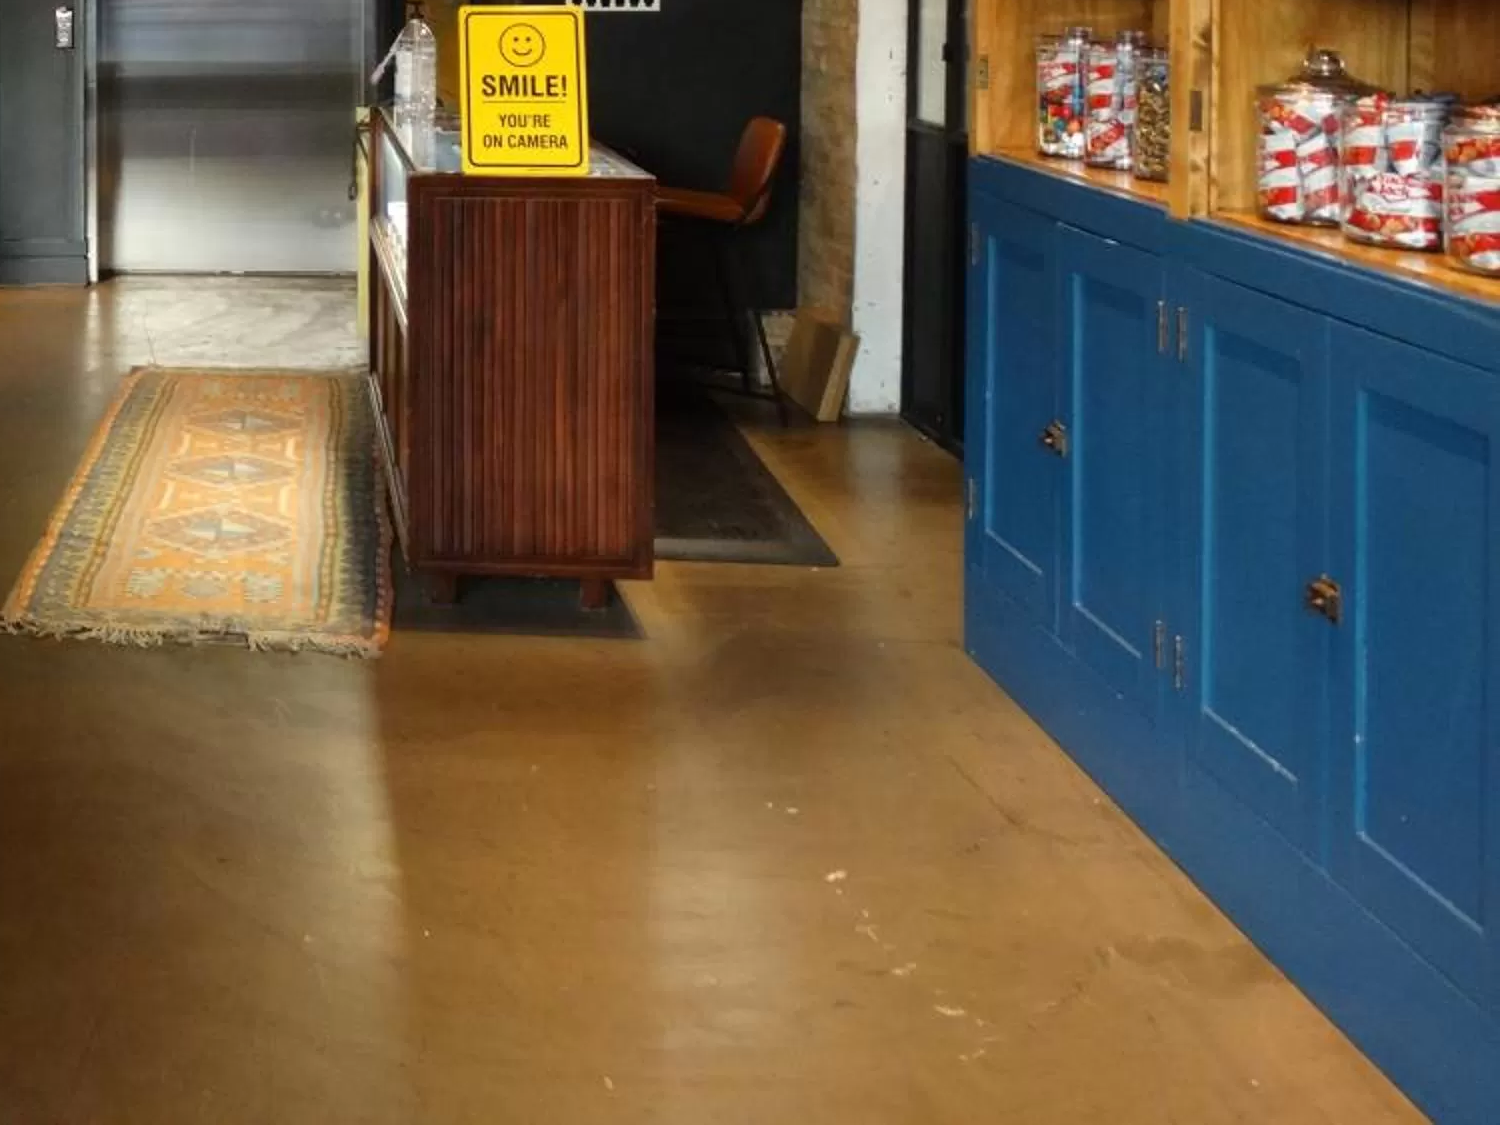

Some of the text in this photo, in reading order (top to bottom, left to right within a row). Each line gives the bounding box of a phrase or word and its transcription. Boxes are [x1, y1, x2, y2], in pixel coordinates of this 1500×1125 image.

[481, 74, 568, 97] SMILE!
[499, 113, 552, 128] YOU'RE
[483, 133, 568, 149] ON CAMERA
